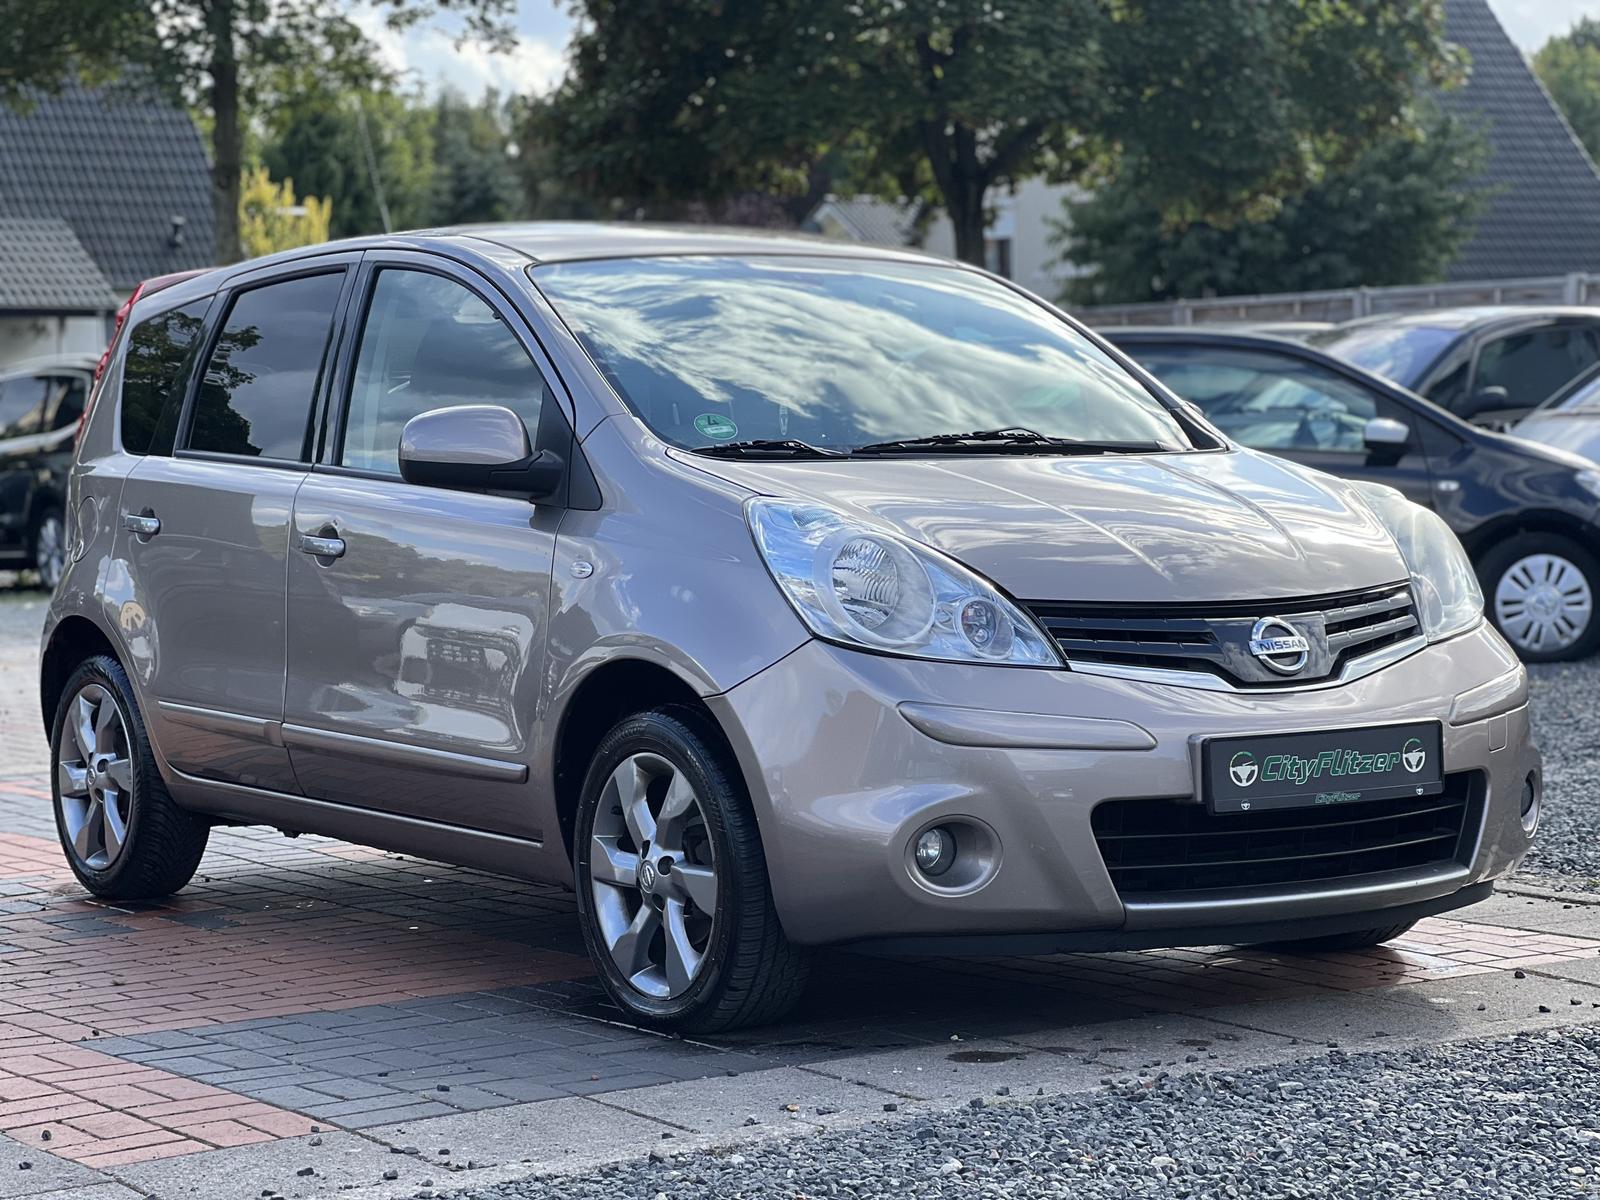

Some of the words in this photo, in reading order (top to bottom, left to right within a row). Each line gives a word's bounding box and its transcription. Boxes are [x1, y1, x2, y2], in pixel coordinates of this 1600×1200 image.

[1259, 639, 1307, 652] NISSAN
[1260, 749, 1401, 785] CityFlitzer
[1314, 791, 1361, 804] CityFlitzer
